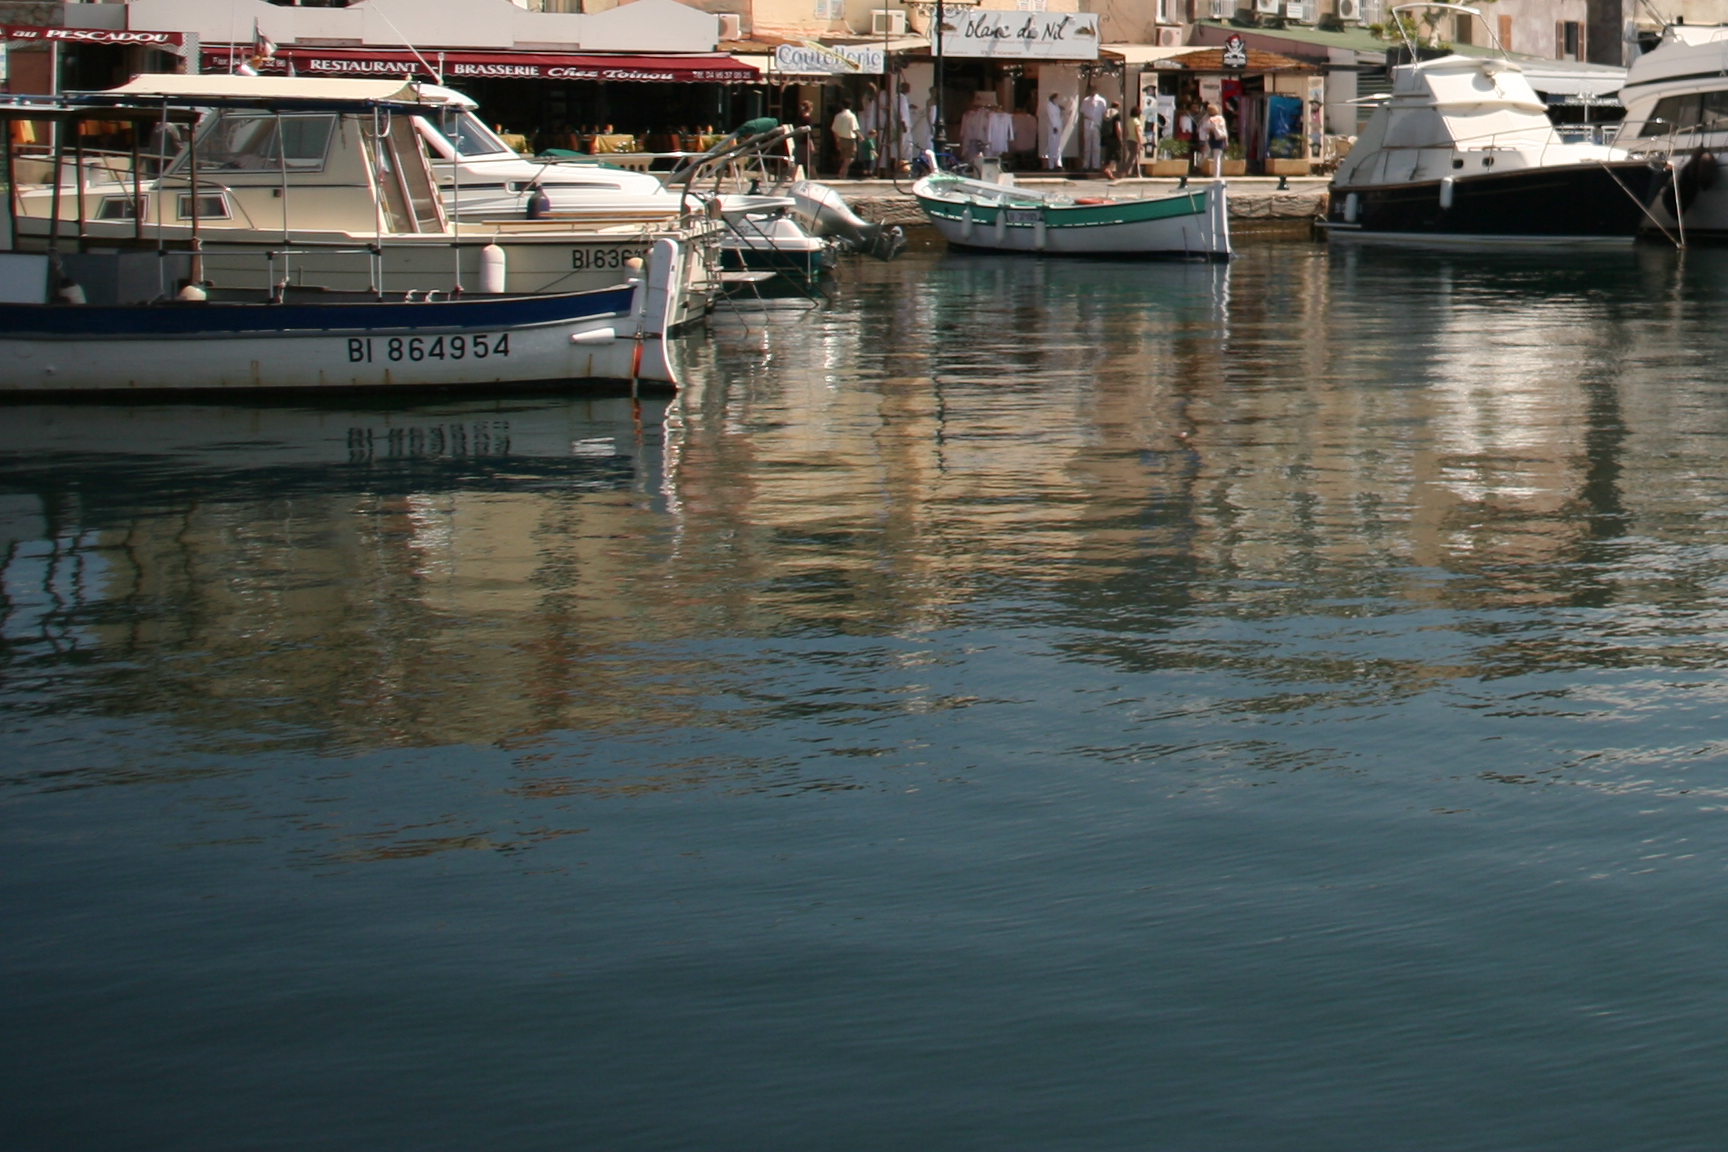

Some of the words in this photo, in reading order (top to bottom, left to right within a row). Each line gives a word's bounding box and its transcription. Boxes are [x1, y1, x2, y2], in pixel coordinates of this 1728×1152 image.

[46, 29, 170, 43] PESCADOU
[310, 59, 419, 73] RESTAURANT
[454, 63, 540, 77] BRASSERIE
[547, 66, 599, 79] Chez
[602, 69, 675, 81] Toinou
[348, 338, 372, 363] BI
[388, 333, 510, 362] 864954
